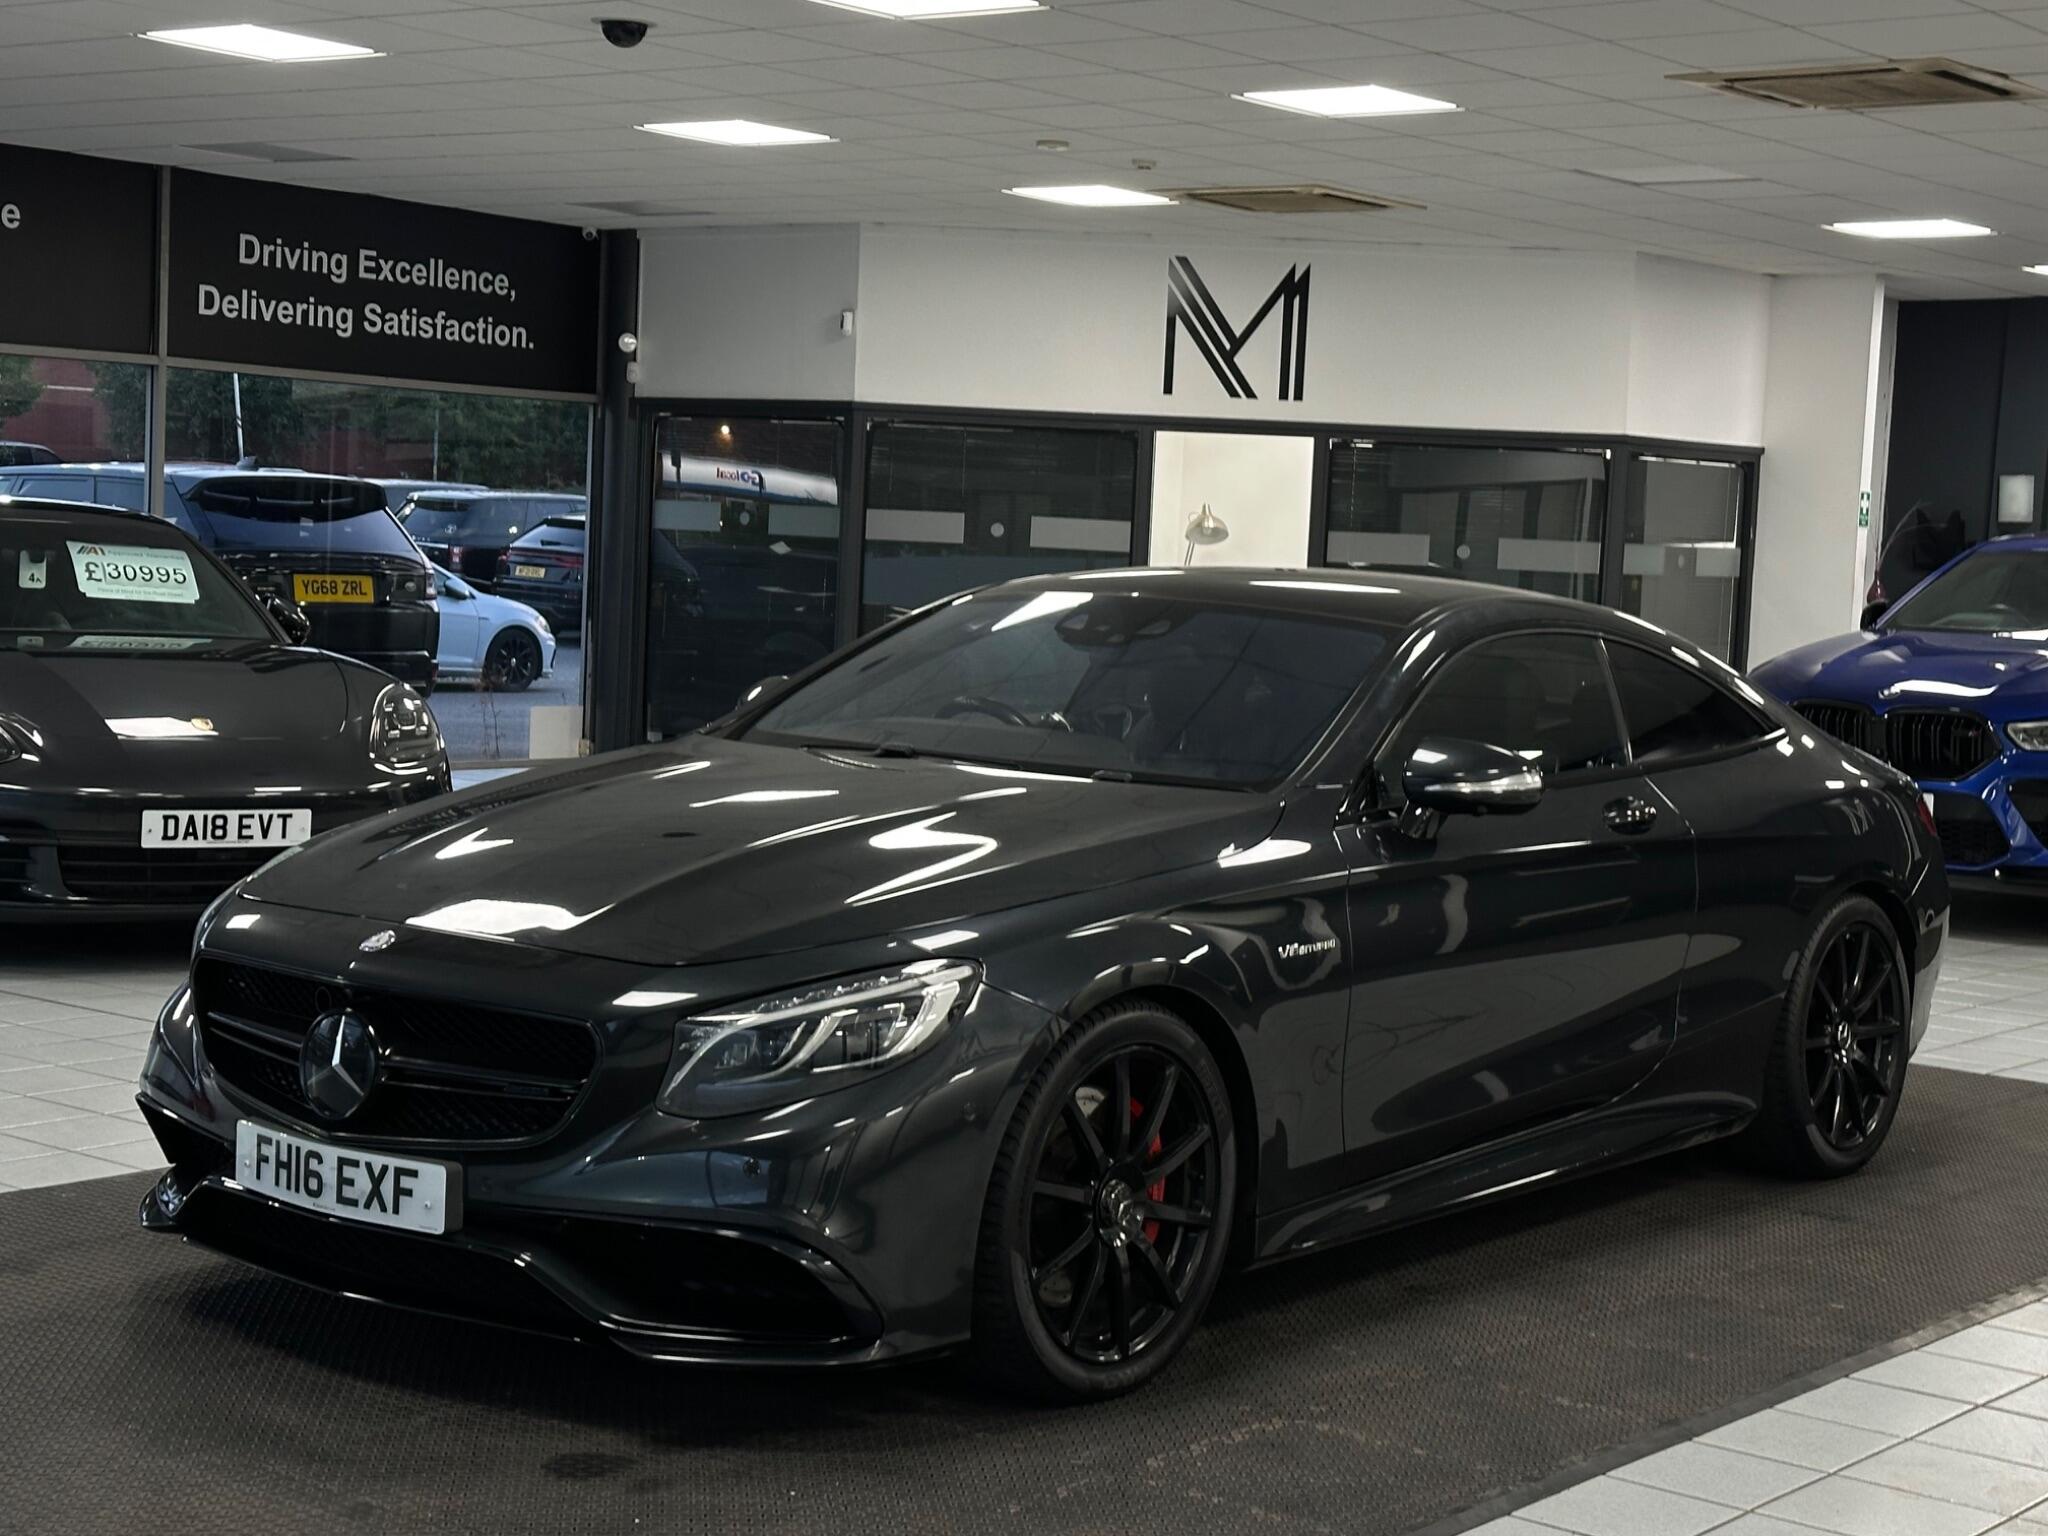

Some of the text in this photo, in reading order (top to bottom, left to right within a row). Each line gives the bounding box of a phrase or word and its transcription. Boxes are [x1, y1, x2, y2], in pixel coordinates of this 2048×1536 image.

[239, 233, 516, 301] Driving Excellence,
[198, 284, 534, 349] Delivering Satisfaction.
[302, 580, 368, 596] YG68 ZRL
[161, 813, 293, 841] DA18 EVT
[256, 1133, 419, 1215] FH16 EXF
